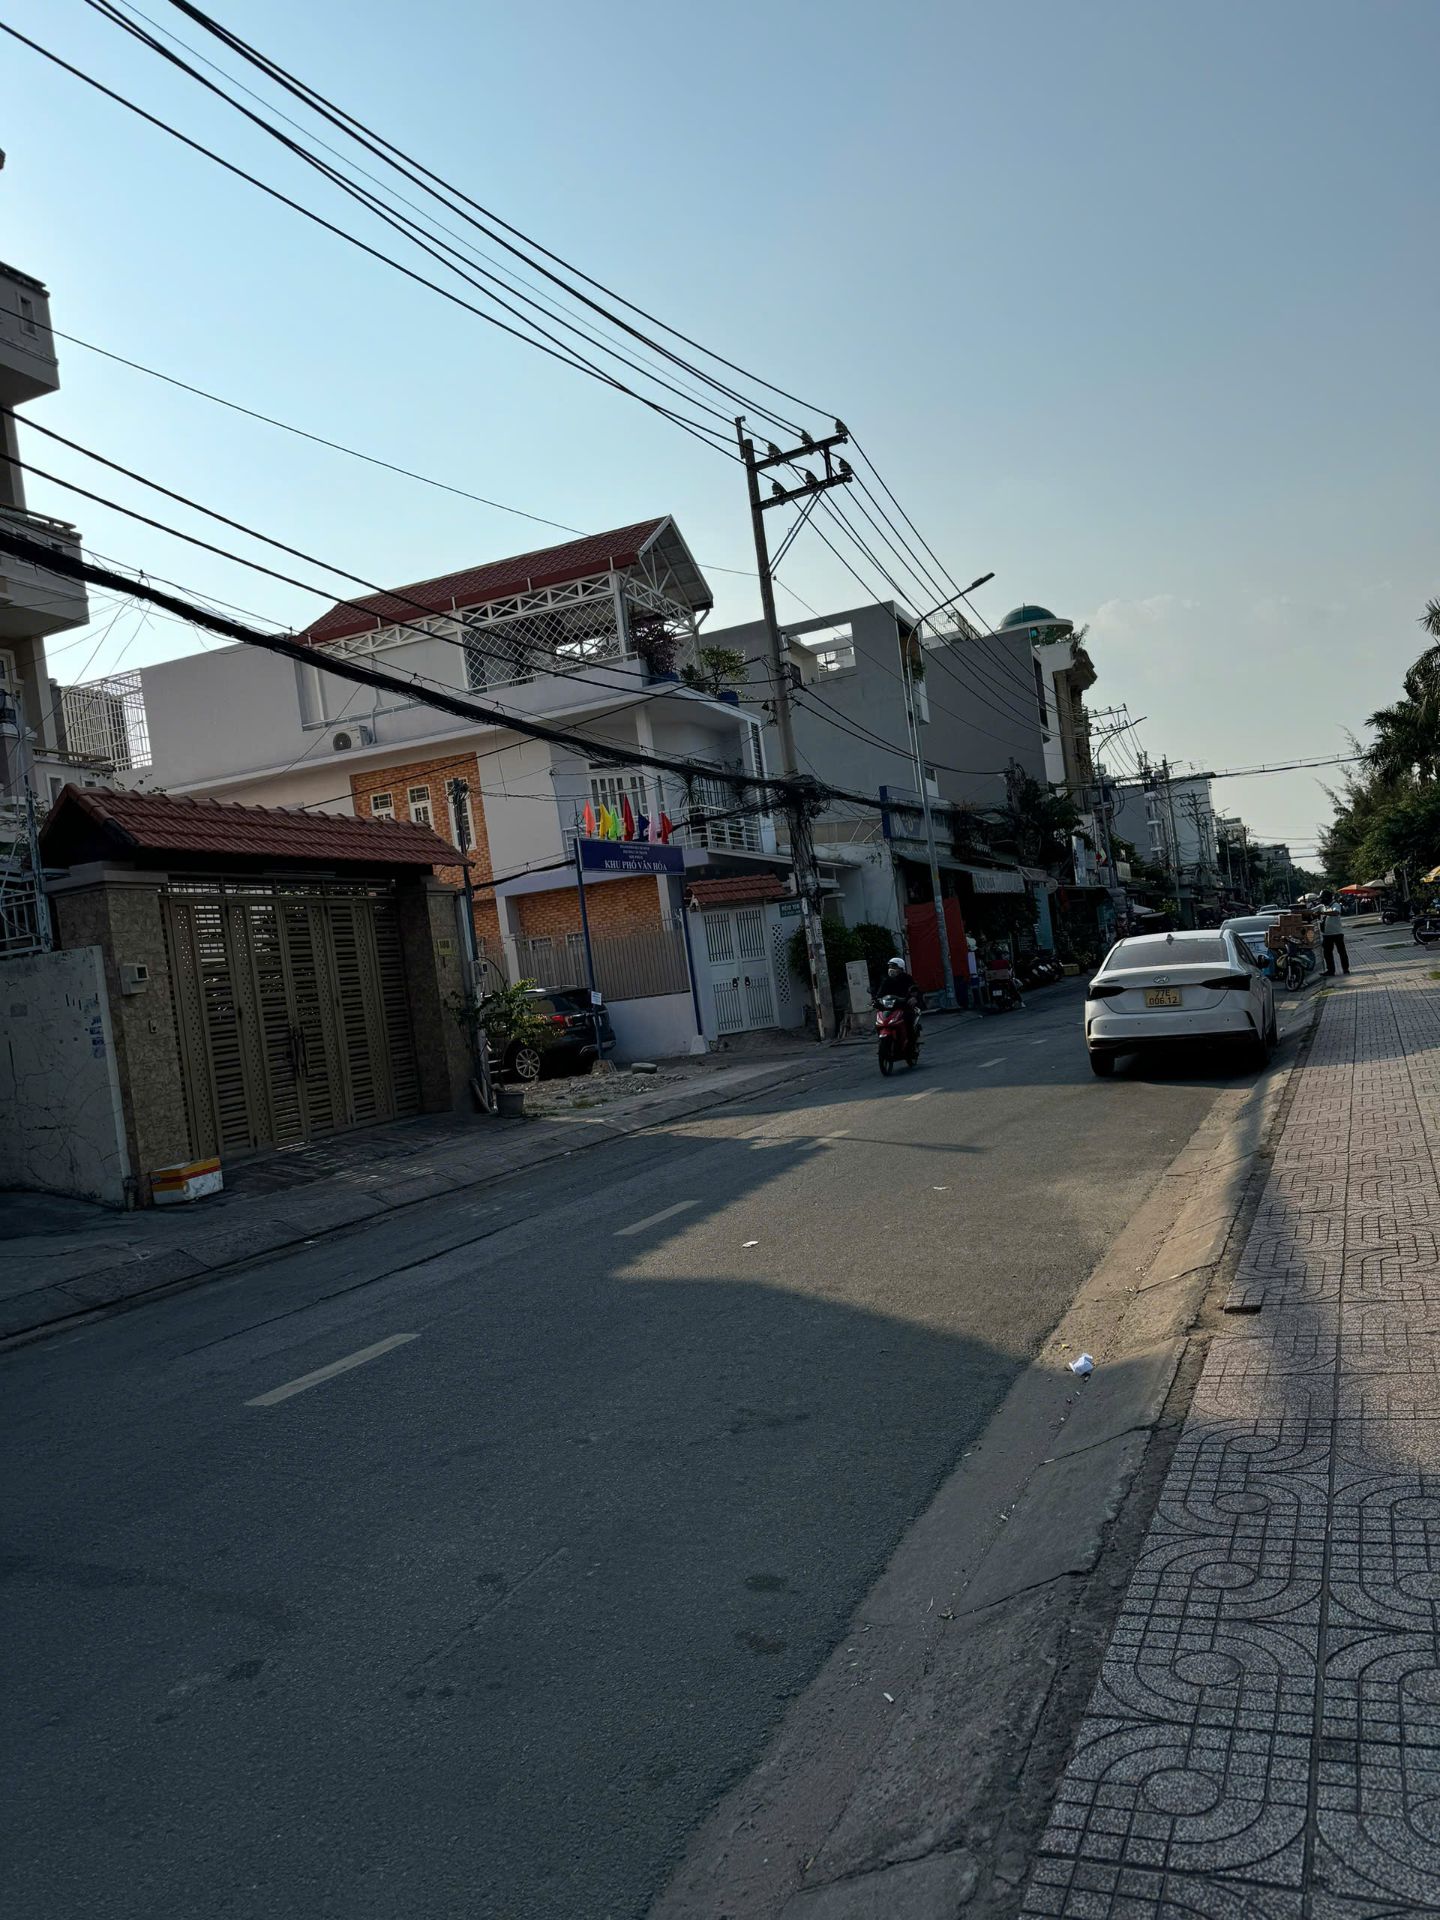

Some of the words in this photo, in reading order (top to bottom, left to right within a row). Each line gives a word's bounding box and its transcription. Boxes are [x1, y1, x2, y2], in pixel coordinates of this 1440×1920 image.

[604, 859, 621, 869] KHU
[652, 860, 667, 870] HÓA
[1155, 988, 1170, 996] 77E
[1149, 996, 1178, 1005] 006.12
